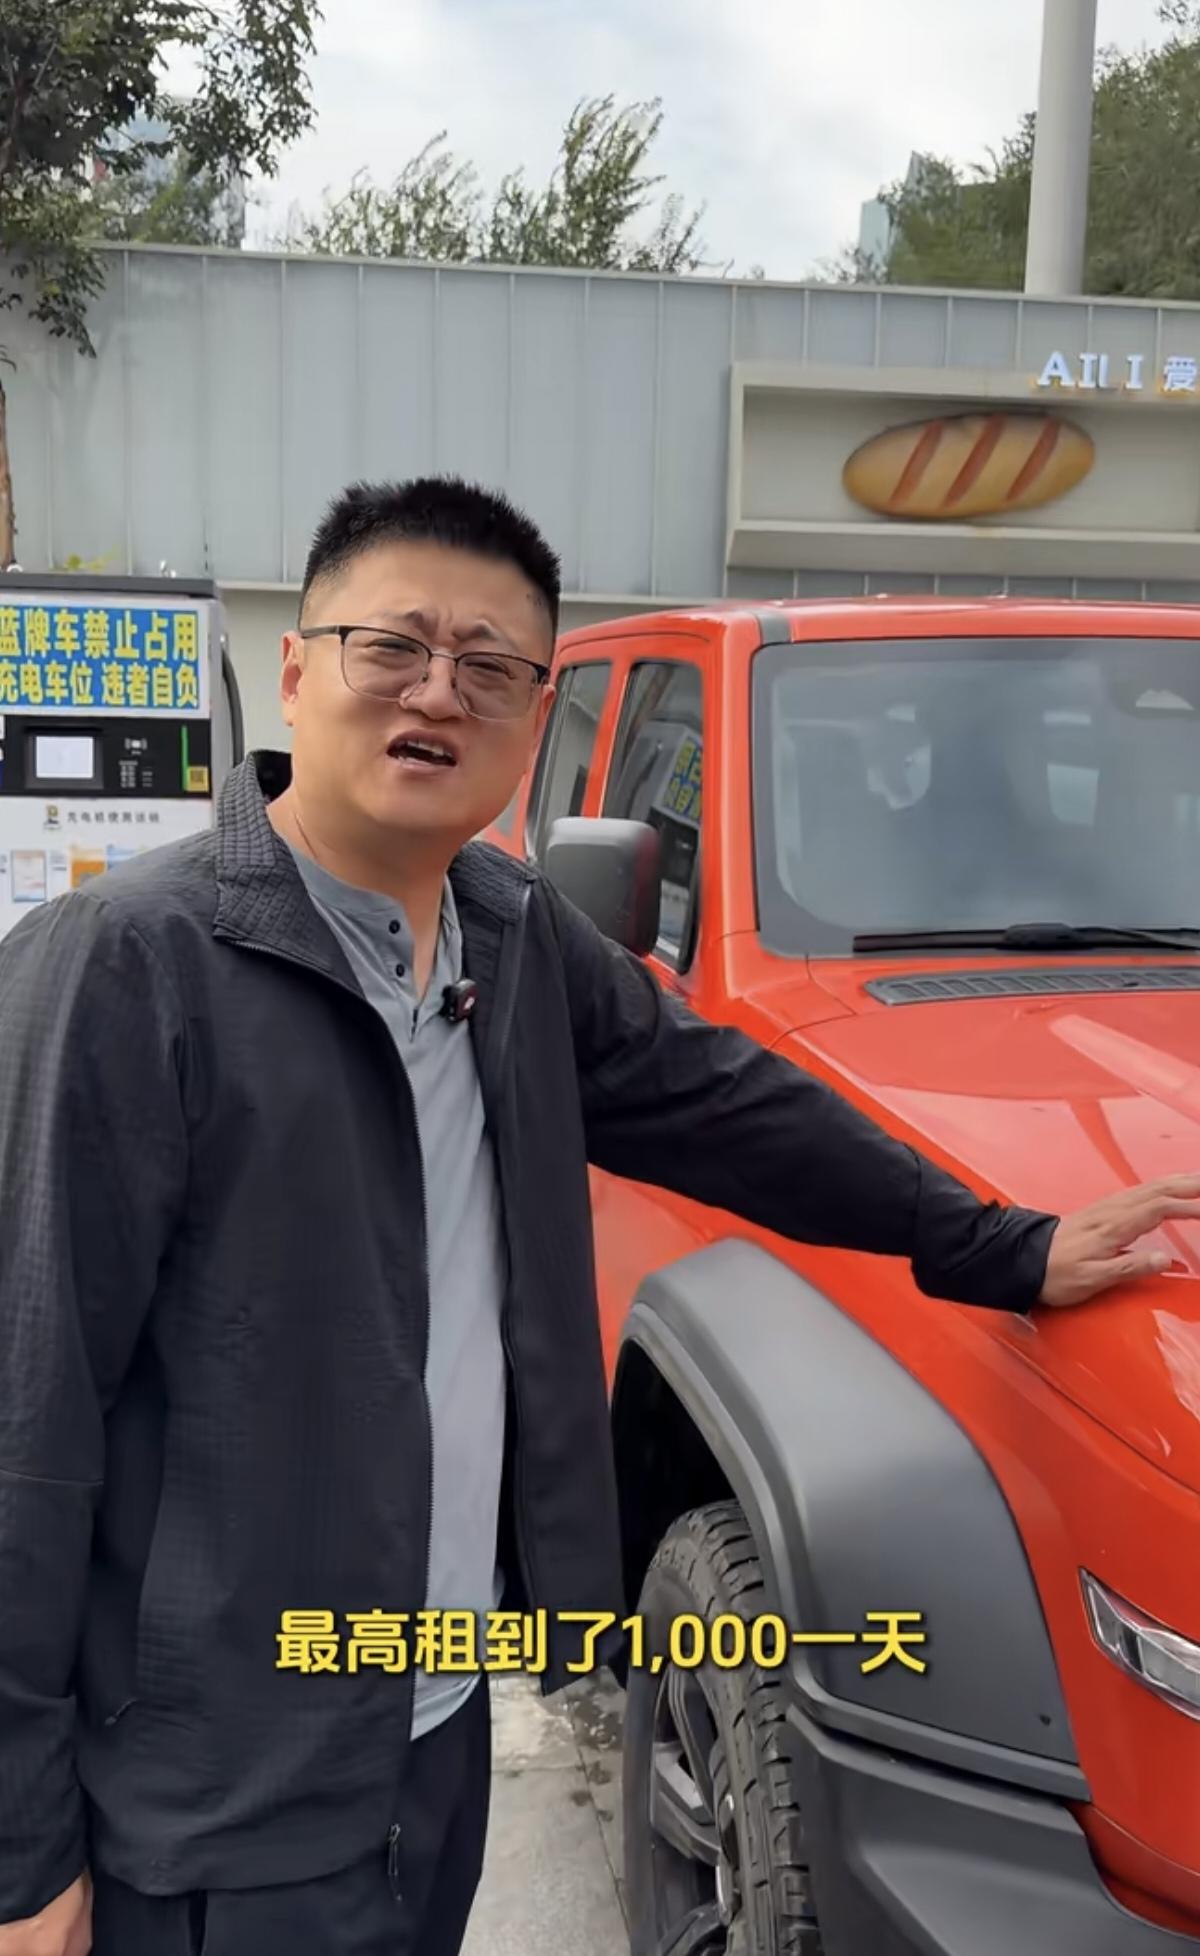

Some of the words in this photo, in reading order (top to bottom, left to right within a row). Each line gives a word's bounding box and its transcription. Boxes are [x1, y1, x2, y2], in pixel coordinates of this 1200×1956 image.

[0, 606, 198, 661] 蓝牌车禁止占用
[0, 659, 94, 705] 充电车位
